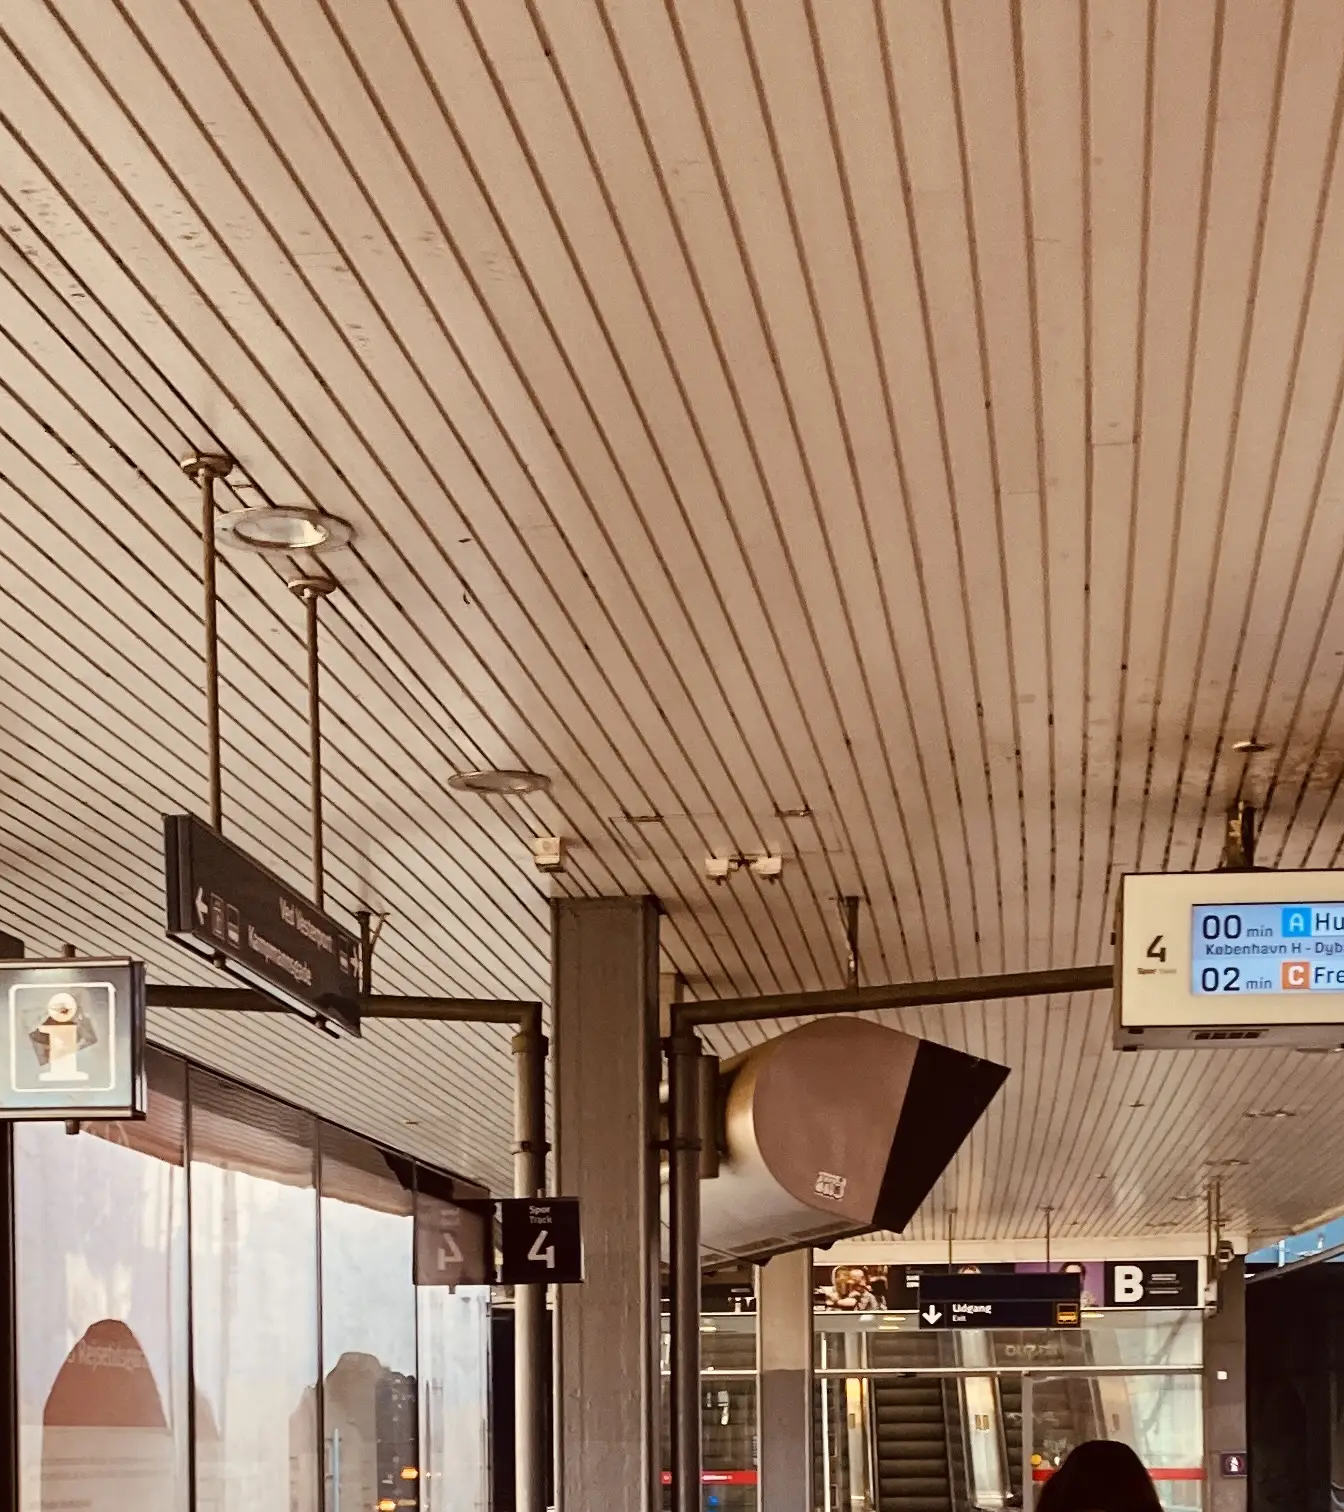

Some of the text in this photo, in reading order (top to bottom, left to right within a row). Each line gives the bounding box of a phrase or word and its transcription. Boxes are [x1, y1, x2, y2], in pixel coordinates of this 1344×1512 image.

[1202, 914, 1242, 940] 00
[1246, 925, 1273, 938] min
[1289, 912, 1305, 932] A
[1146, 935, 1167, 963] 4
[1206, 942, 1287, 956] København
[1291, 942, 1302, 954] H
[1202, 966, 1241, 992] 02
[1245, 977, 1273, 990] min
[1288, 965, 1305, 986] C
[527, 1229, 556, 1269] 4
[1113, 1265, 1144, 1303] B
[952, 1303, 992, 1314] Udgang
